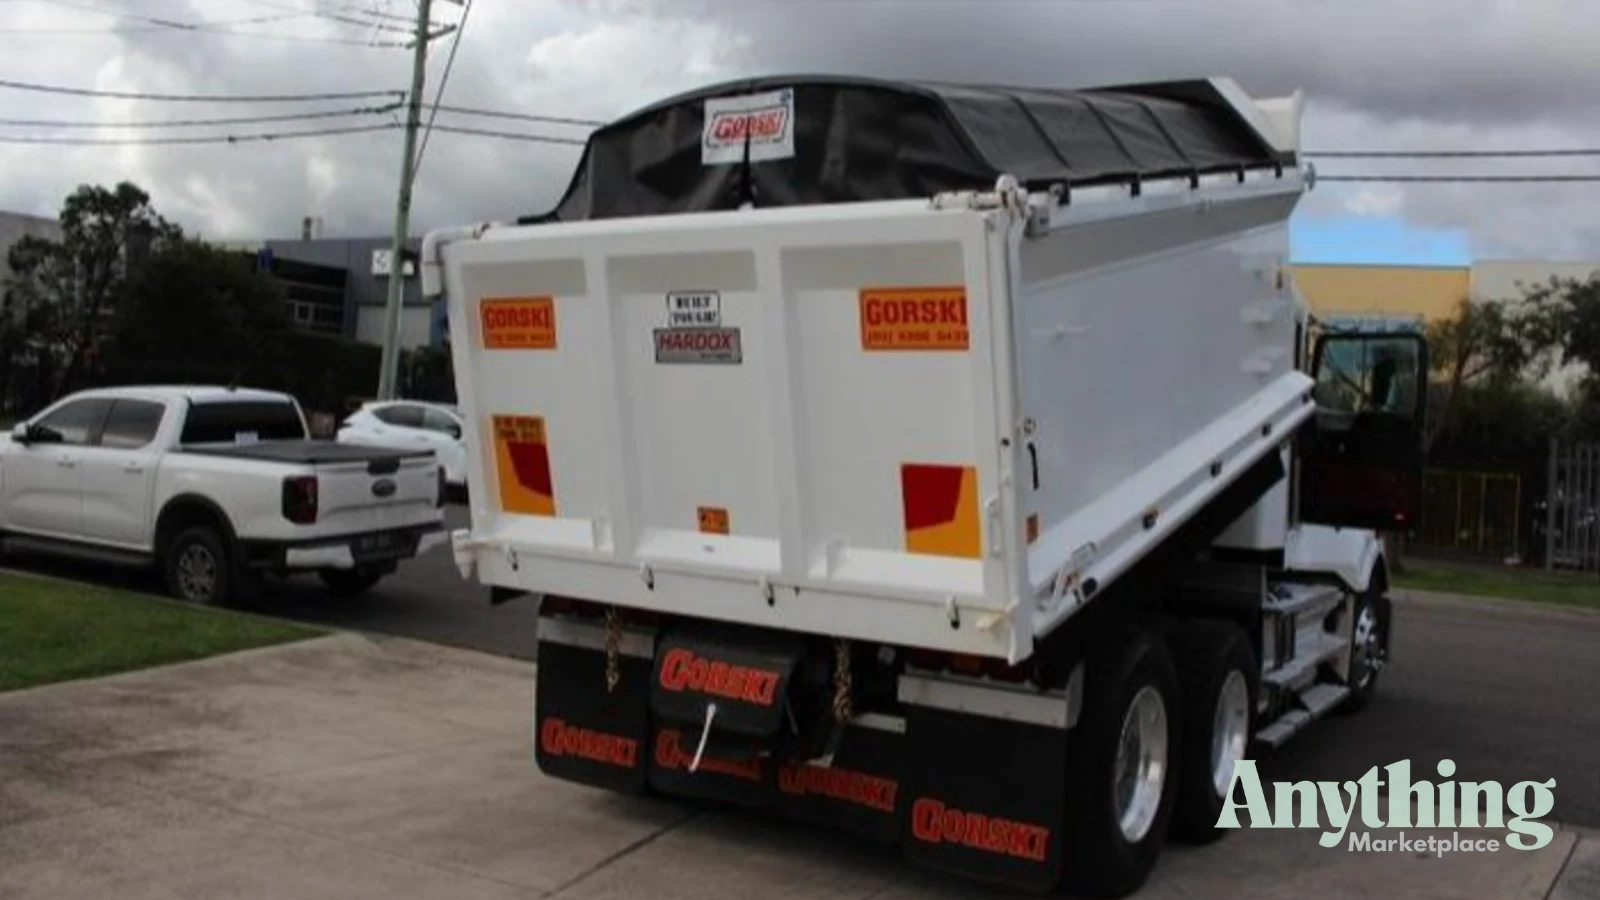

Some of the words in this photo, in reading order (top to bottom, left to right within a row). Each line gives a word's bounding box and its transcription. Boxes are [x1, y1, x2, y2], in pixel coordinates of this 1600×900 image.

[485, 306, 549, 330] GORSKI
[866, 296, 967, 325] GORSKI
[659, 332, 732, 351] HARDOX
[660, 648, 778, 706] GORSKI
[541, 716, 637, 768] GORSKI
[913, 797, 1049, 862] GORSKI
